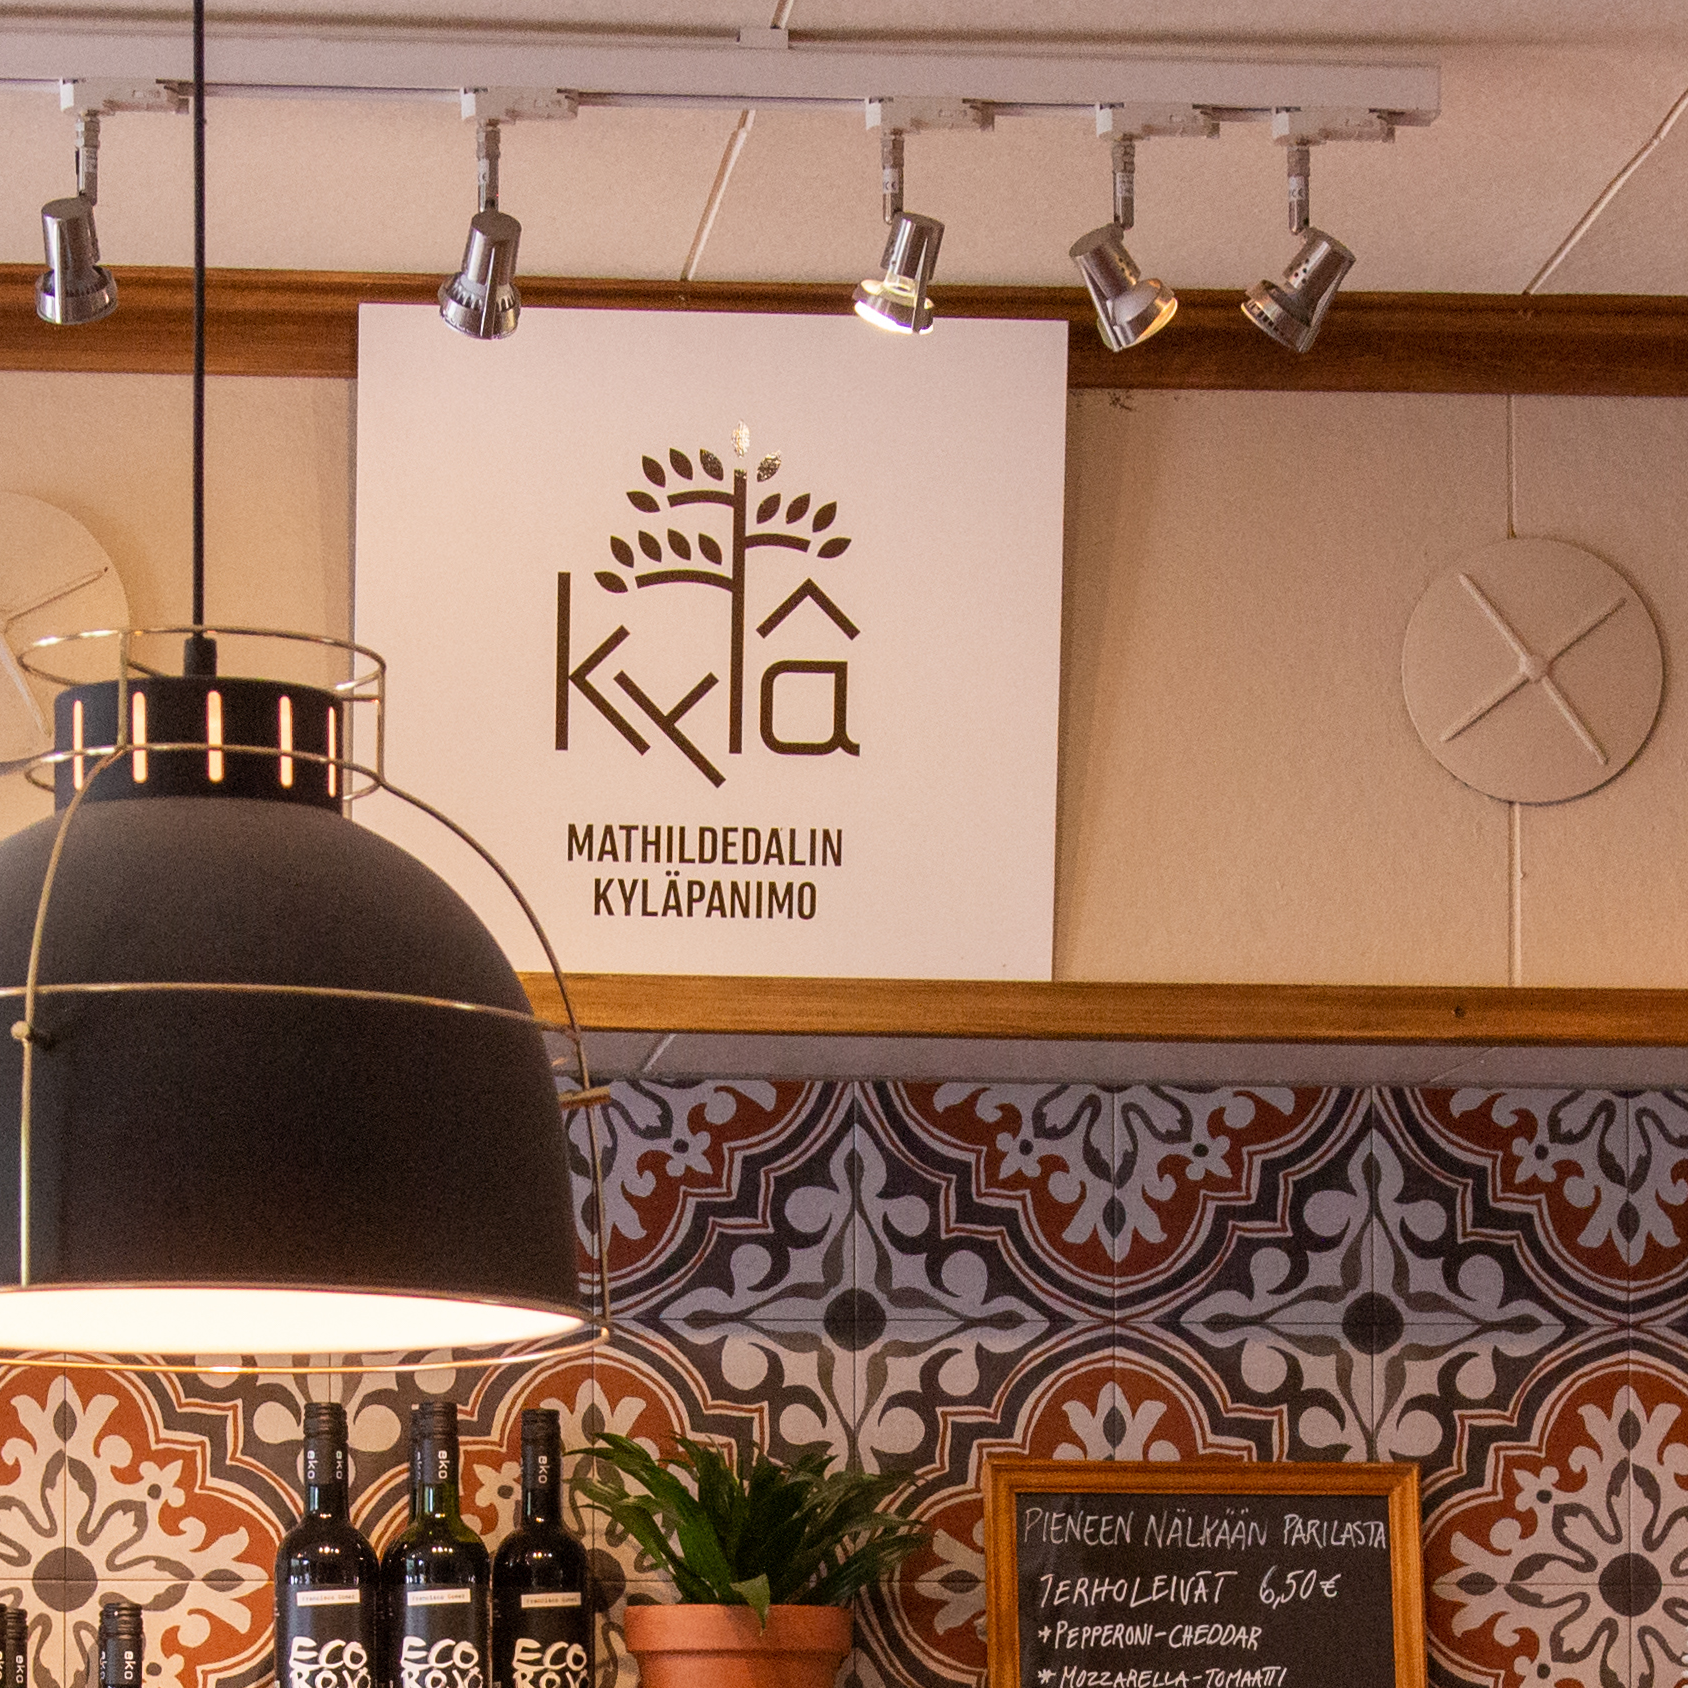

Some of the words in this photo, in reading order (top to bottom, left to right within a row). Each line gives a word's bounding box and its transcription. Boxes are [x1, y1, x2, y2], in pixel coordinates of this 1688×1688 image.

[566, 822, 844, 868] MATHILDEDALIN
[592, 870, 818, 921] KYLÄPANIMO
[1024, 1507, 1136, 1547] PIENEEN
[1144, 1507, 1268, 1550] NÄLKÄÄN
[1283, 1514, 1389, 1549] PARILASTA
[289, 1636, 367, 1670] ECO
[400, 1636, 479, 1670] ECO
[512, 1638, 588, 1671] ECO
